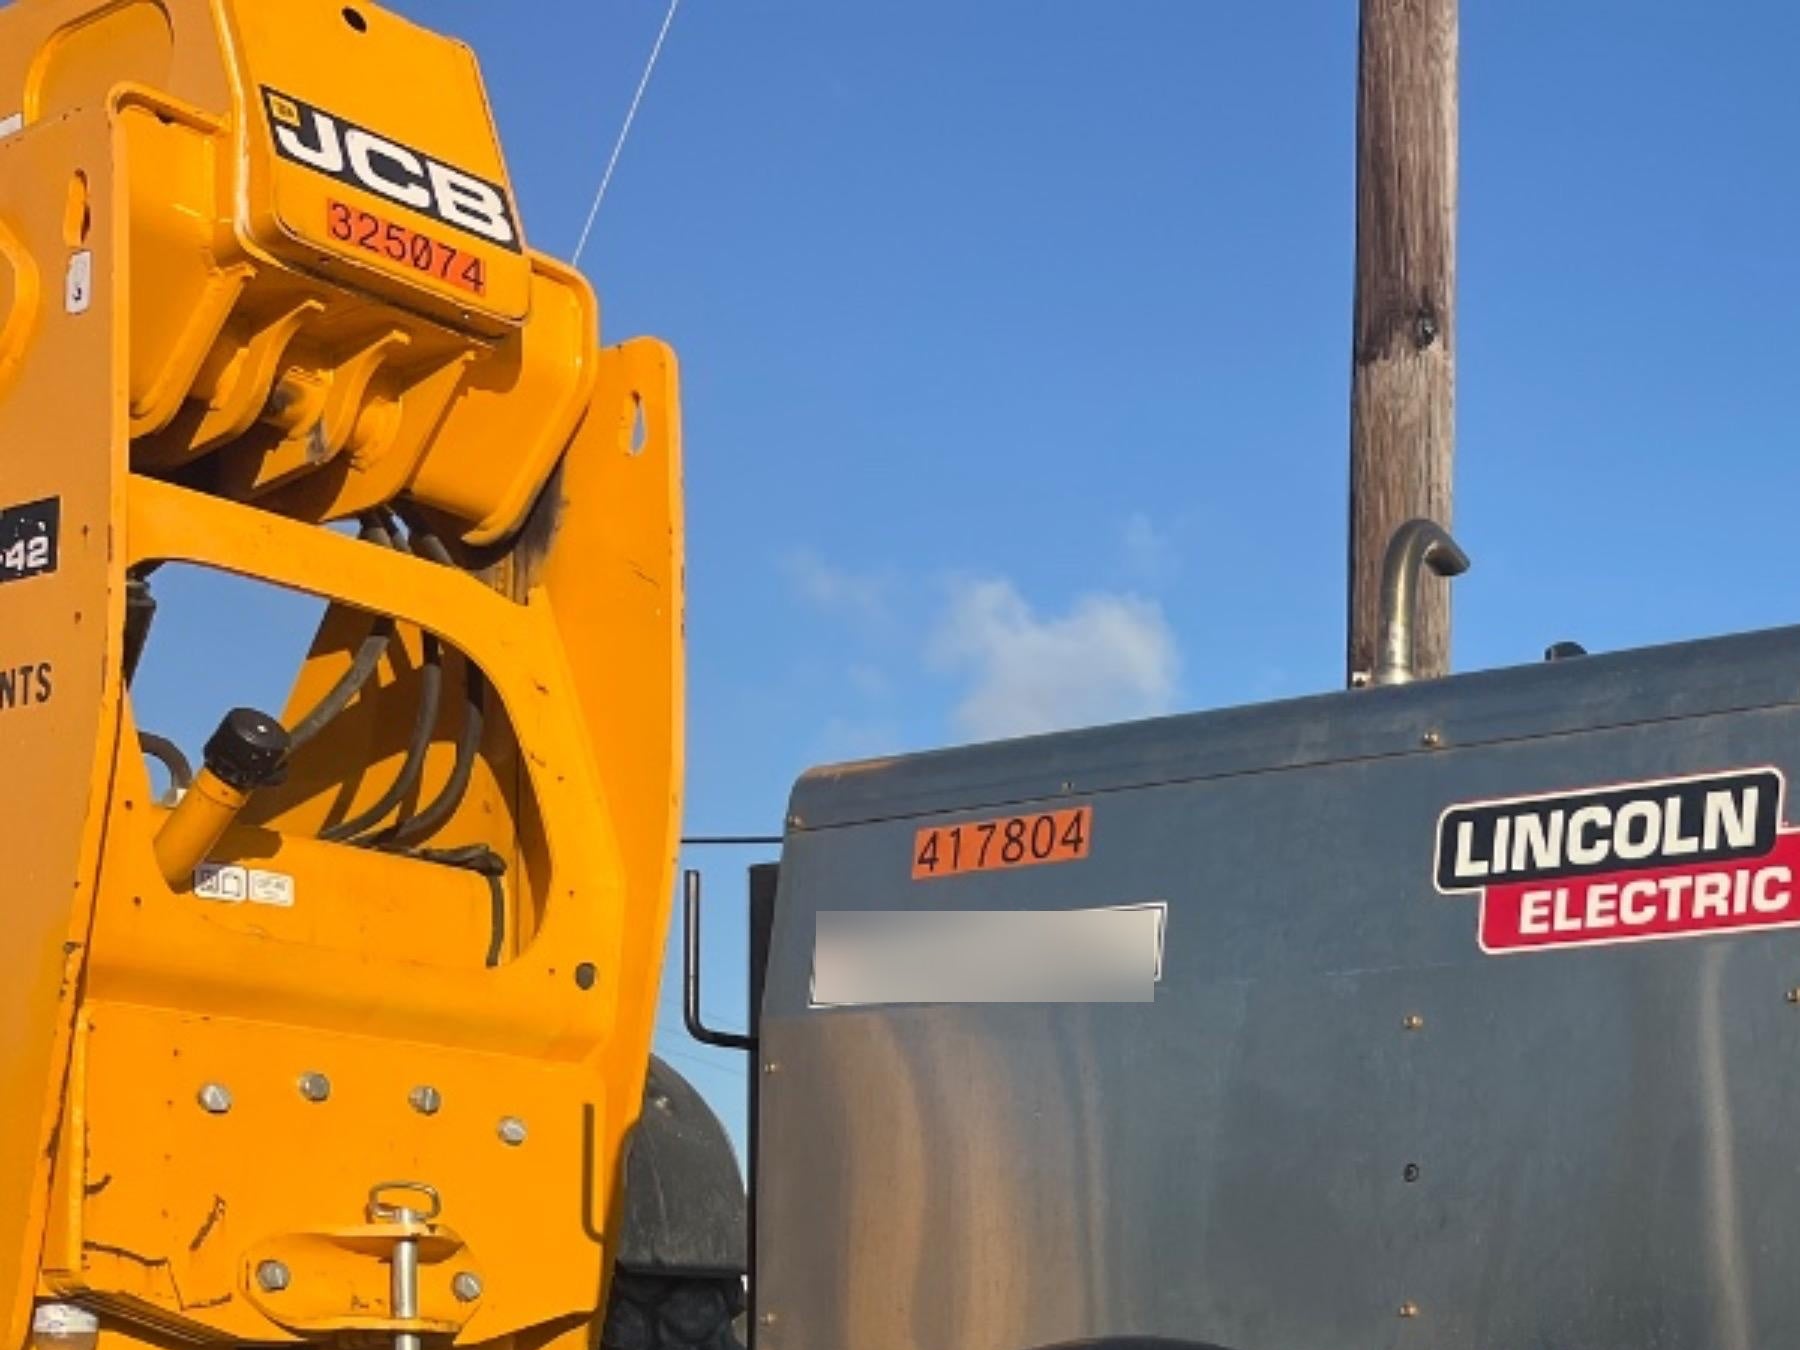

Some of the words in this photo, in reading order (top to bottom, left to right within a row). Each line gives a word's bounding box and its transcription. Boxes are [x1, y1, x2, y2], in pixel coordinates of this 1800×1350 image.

[275, 111, 513, 242] JCB
[330, 202, 485, 294] 325074
[917, 809, 1084, 872] 417804
[1454, 786, 1760, 878] LINCOLN
[1519, 865, 1793, 935] ELECTRIC
